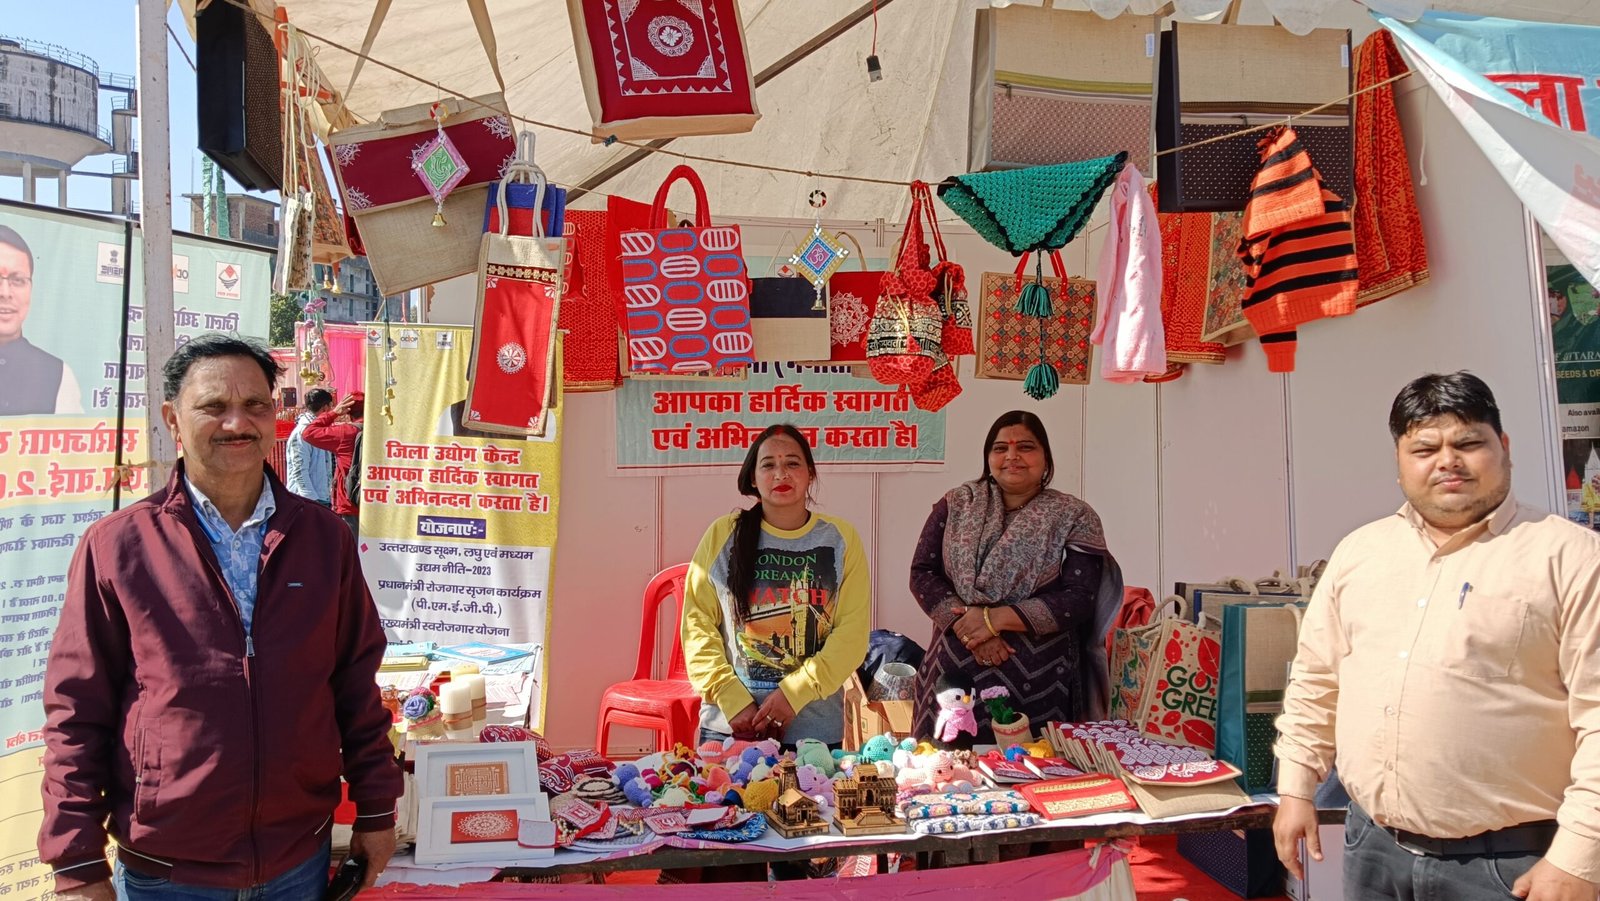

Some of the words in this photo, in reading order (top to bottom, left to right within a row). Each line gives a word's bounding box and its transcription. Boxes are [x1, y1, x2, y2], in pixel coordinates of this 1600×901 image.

[653, 391, 741, 415] आपका
[748, 384, 827, 414] हार्दिक
[833, 390, 911, 413] स्वागत
[652, 422, 691, 450] एवं
[825, 427, 888, 449] करता
[889, 420, 918, 449] है।
[1562, 425, 1589, 433] amazon
[386, 441, 430, 460] जिला
[434, 443, 477, 463] उद्योग
[482, 445, 520, 465] केन्द्र
[367, 465, 424, 482] आपका
[429, 466, 479, 485] हार्दिक
[484, 472, 539, 488] स्वागत
[363, 486, 390, 503] एवं
[395, 487, 472, 508] अभिनन्दन
[477, 494, 522, 511] करता
[527, 493, 549, 512] है।
[379, 541, 432, 555] उत्तराखण्ड
[464, 548, 483, 561] लघु
[484, 547, 498, 559] एवं
[499, 550, 534, 560] मध्यम
[757, 553, 817, 567] ONDON
[416, 562, 440, 574] उद्यम
[378, 579, 425, 592] प्रधानमंत्री
[426, 580, 464, 594] रोजगार
[466, 586, 495, 600] सृजन
[496, 586, 541, 599] कार्यक्रम
[422, 621, 475, 634] स्वरोजगार
[476, 622, 510, 637] योजना
[1167, 667, 1211, 694] GO
[1163, 688, 1217, 721] GREE
